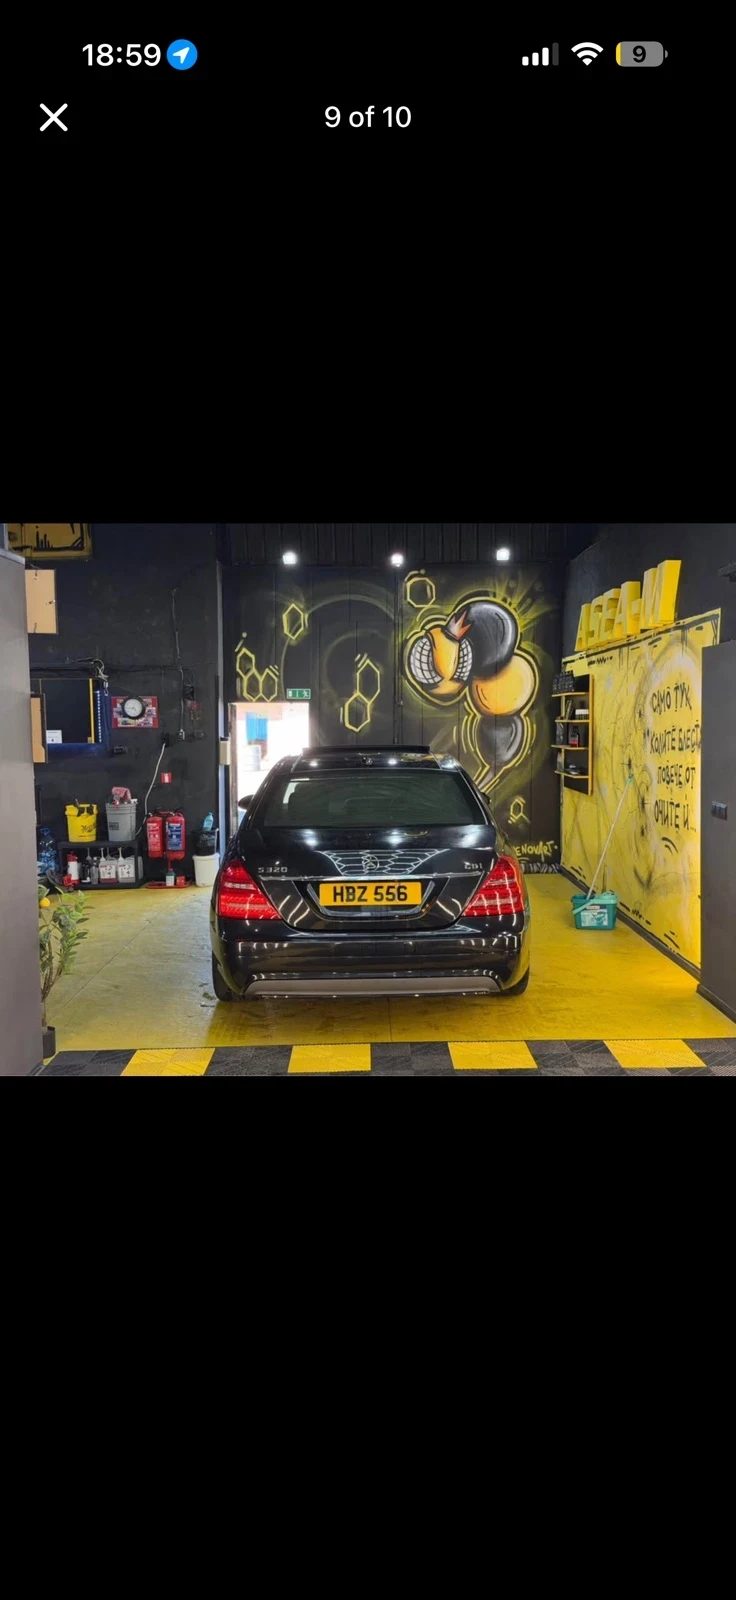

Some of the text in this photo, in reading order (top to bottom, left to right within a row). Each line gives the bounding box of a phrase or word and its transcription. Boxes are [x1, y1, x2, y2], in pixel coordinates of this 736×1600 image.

[685, 766, 696, 790] ОТ
[333, 885, 408, 903] HBZ 556
